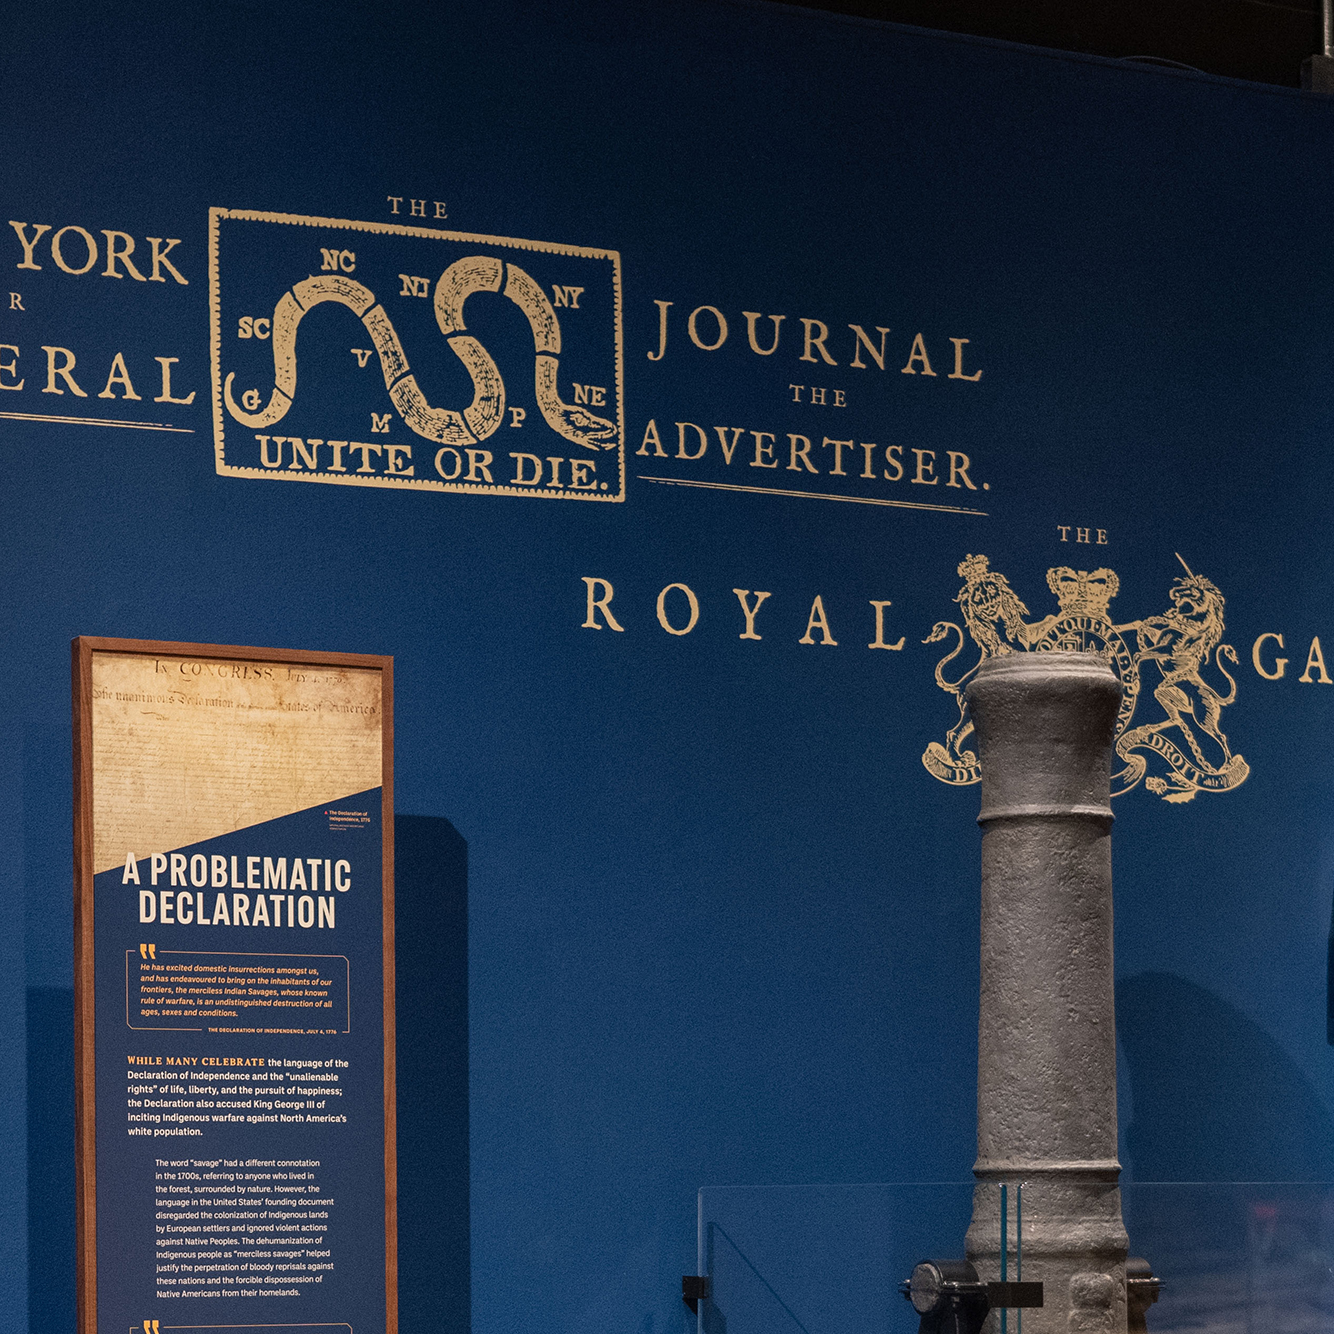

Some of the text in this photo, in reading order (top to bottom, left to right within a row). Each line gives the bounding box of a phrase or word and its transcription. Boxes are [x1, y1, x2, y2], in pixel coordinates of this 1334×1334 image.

[386, 195, 448, 219] THE
[7, 221, 190, 284] YORK
[320, 247, 357, 275] NC
[397, 273, 431, 298] NJ
[550, 284, 585, 312] NY
[237, 315, 271, 340] SC
[646, 300, 983, 381] JOURNAL
[349, 347, 372, 368] V
[241, 388, 262, 411] G
[570, 382, 607, 408] NE
[788, 383, 847, 408] THE
[370, 411, 393, 434] M
[507, 406, 527, 428] P
[255, 434, 610, 491] UNITE OR DIE.
[634, 421, 990, 490] ADVERTISER.
[1056, 524, 1108, 545] THE
[580, 577, 906, 650] ROYAL
[1151, 734, 1204, 785] DROIT
[121, 851, 352, 893] A PROBLEMATIC
[138, 890, 335, 928] DECLARATION
[139, 963, 320, 976] He has excited domestic insurrections amongst us,
[126, 1055, 349, 1070] WHILE MANY CELEBRATE the language of the
[126, 1070, 339, 1082] Declaration of Independence and the "unalienable
[154, 1158, 321, 1169] The word "savage" had a different connotation
